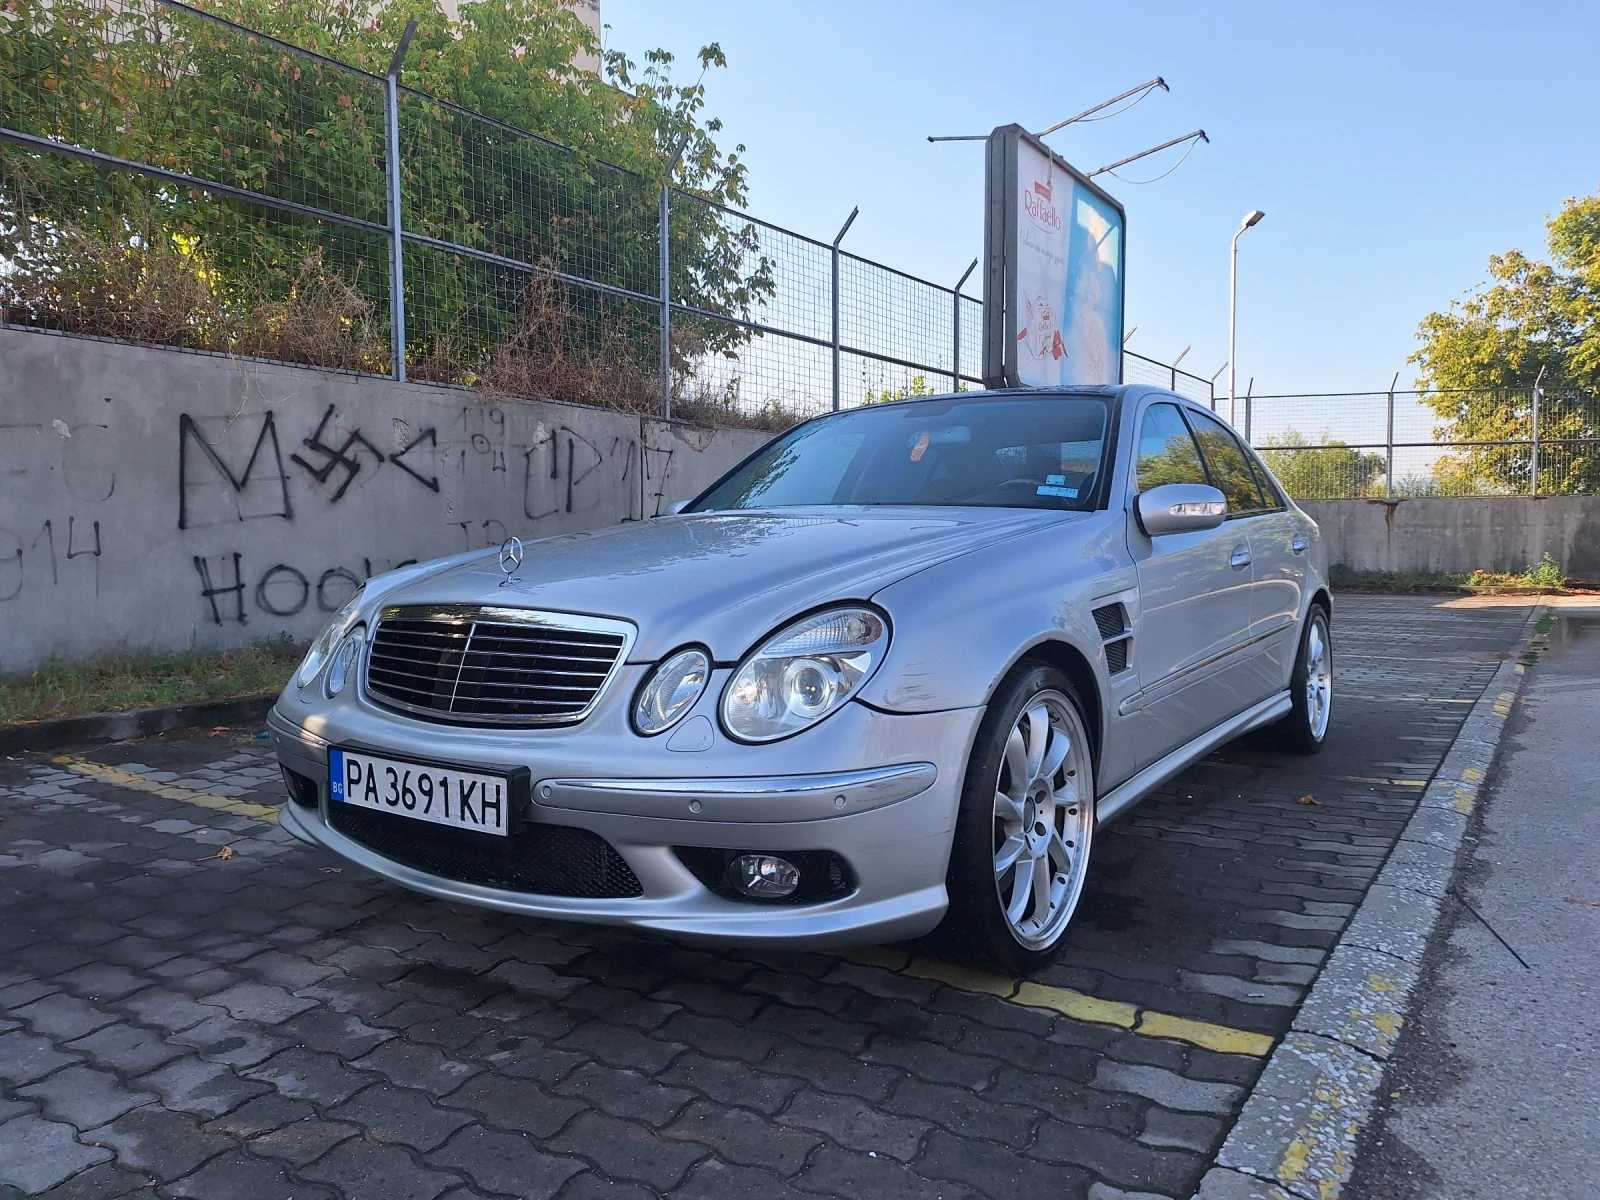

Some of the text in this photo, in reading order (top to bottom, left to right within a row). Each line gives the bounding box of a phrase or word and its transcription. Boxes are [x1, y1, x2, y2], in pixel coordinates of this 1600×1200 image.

[1024, 189, 1061, 231] Raffaello
[332, 758, 501, 828] BG PA3691KH
